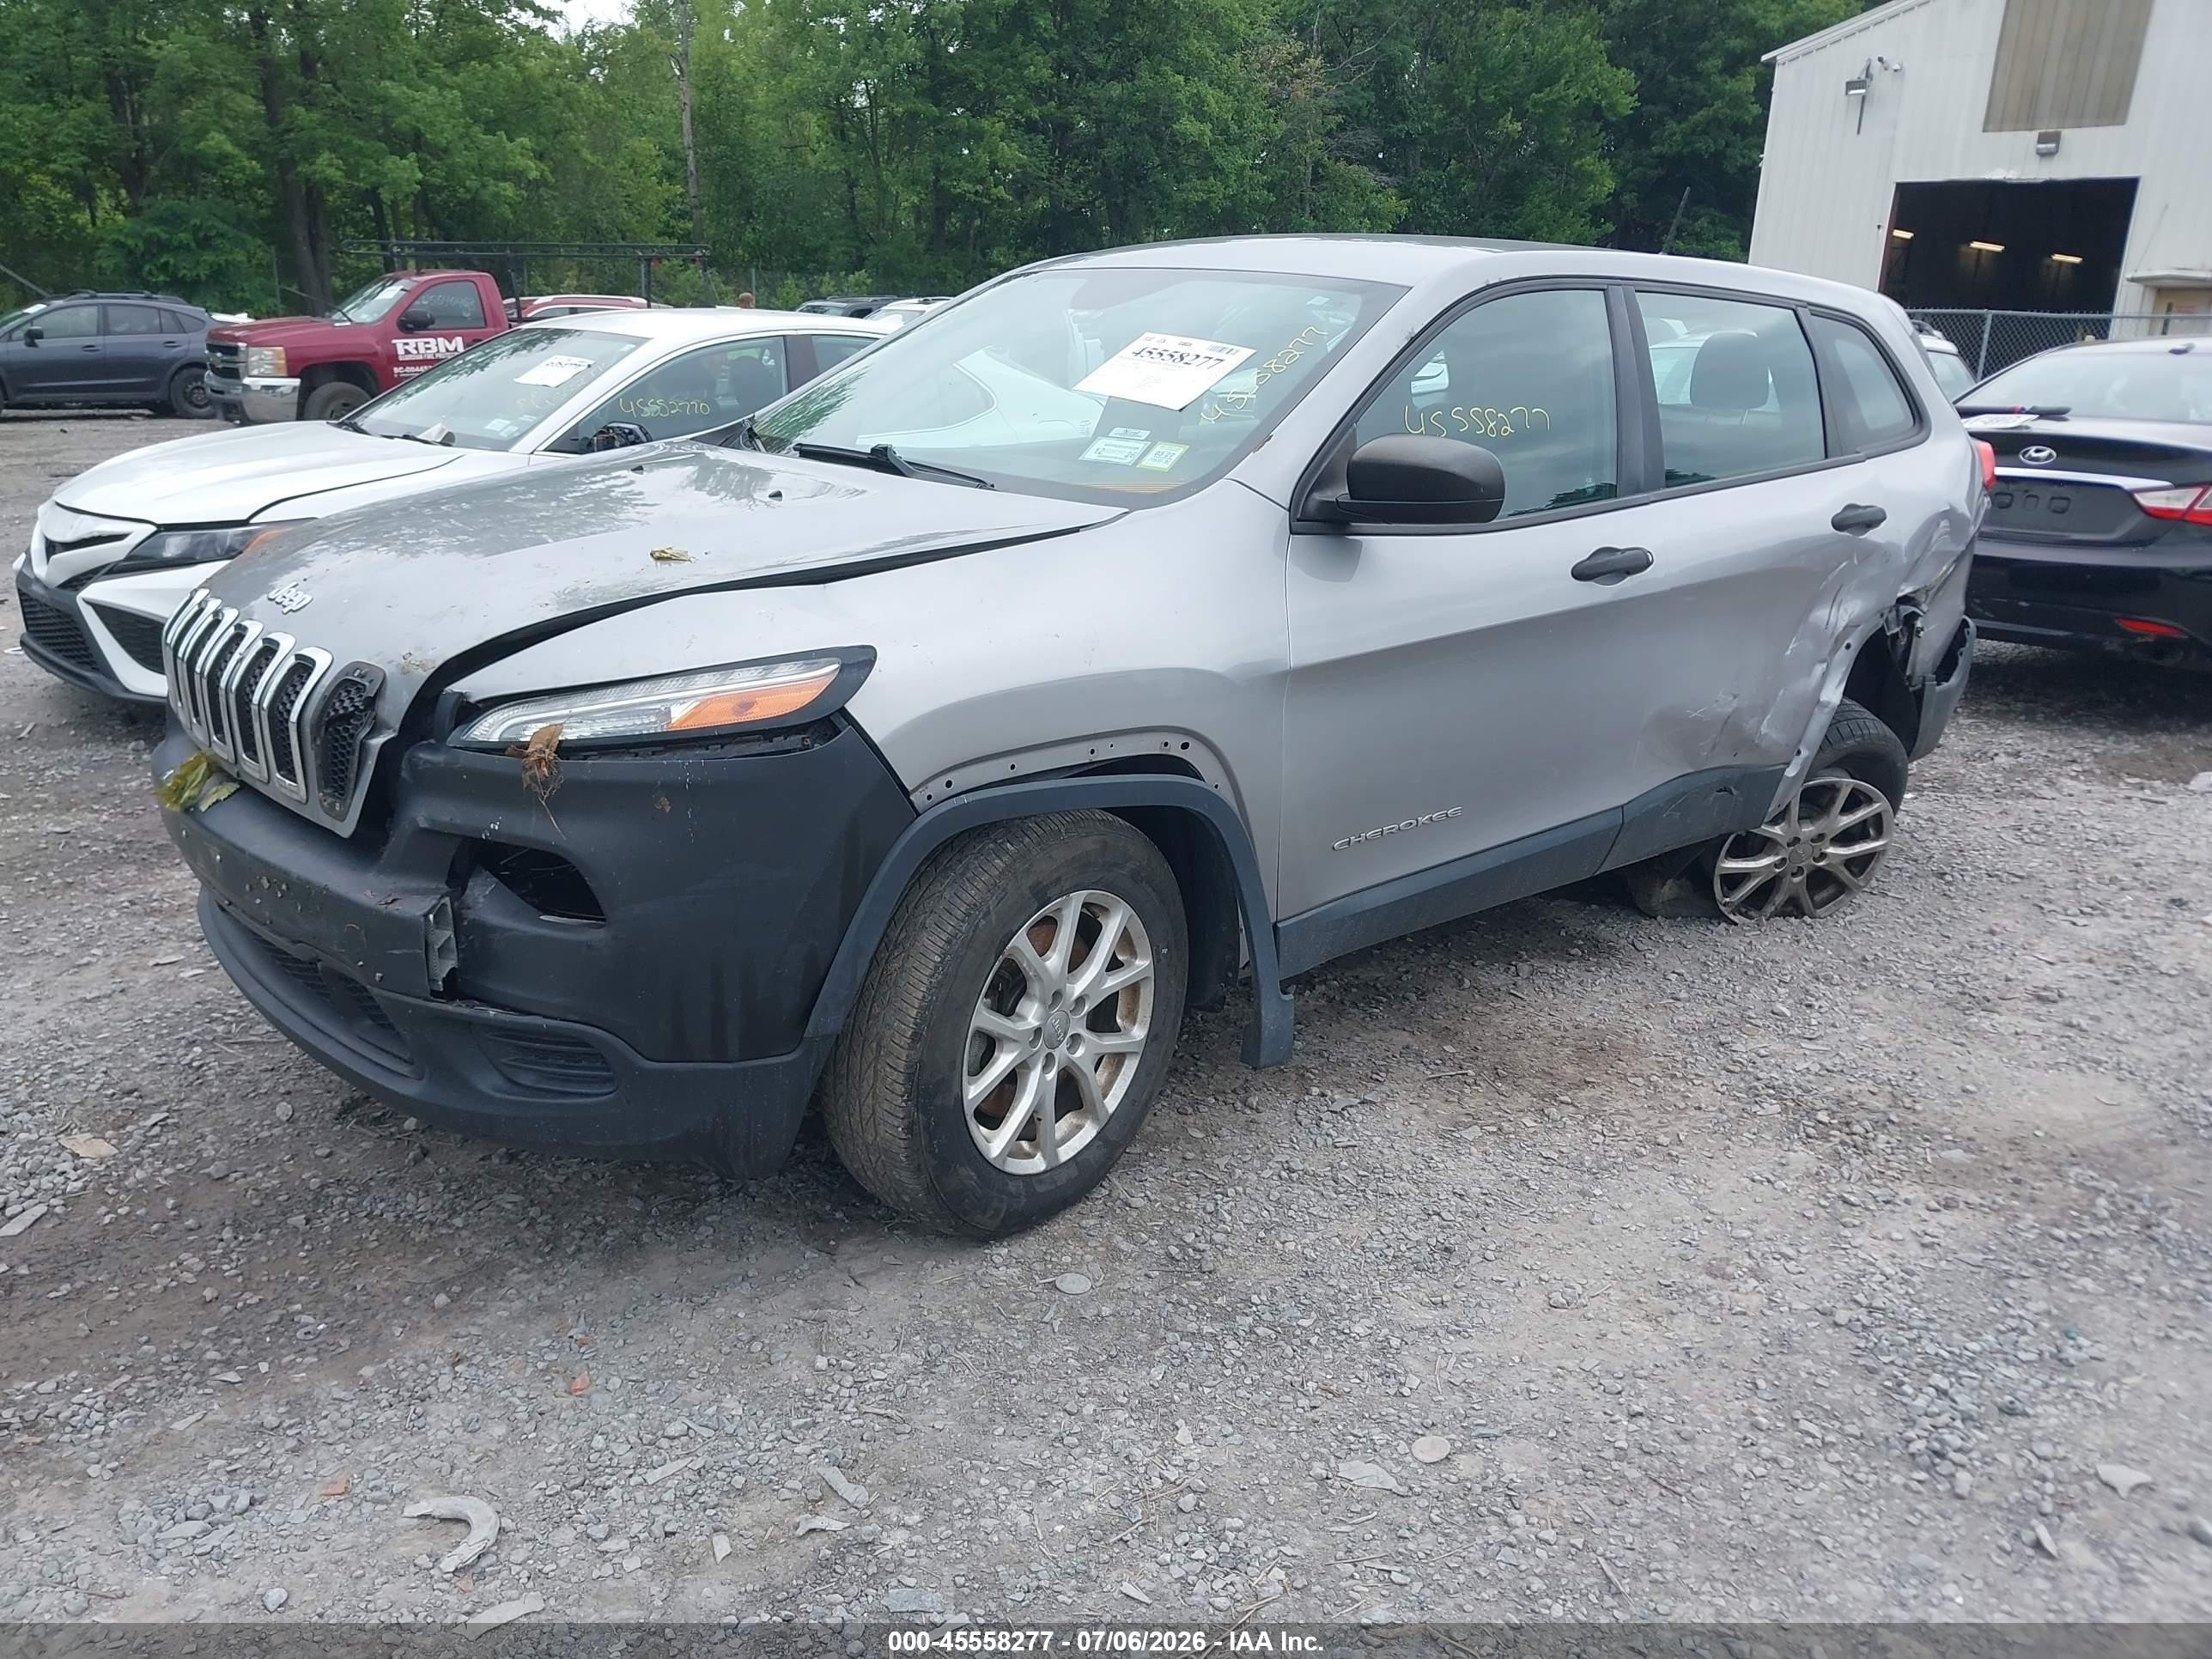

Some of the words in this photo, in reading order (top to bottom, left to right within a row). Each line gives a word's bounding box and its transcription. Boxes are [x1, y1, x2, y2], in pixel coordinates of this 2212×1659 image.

[392, 336, 465, 356] RBM
[1132, 346, 1225, 370] 45558277
[1404, 404, 1550, 438] 45558277
[267, 581, 314, 616] Jeep
[1332, 805, 1463, 851] CHEROKEE
[1051, 1016, 1065, 1042] Jeep
